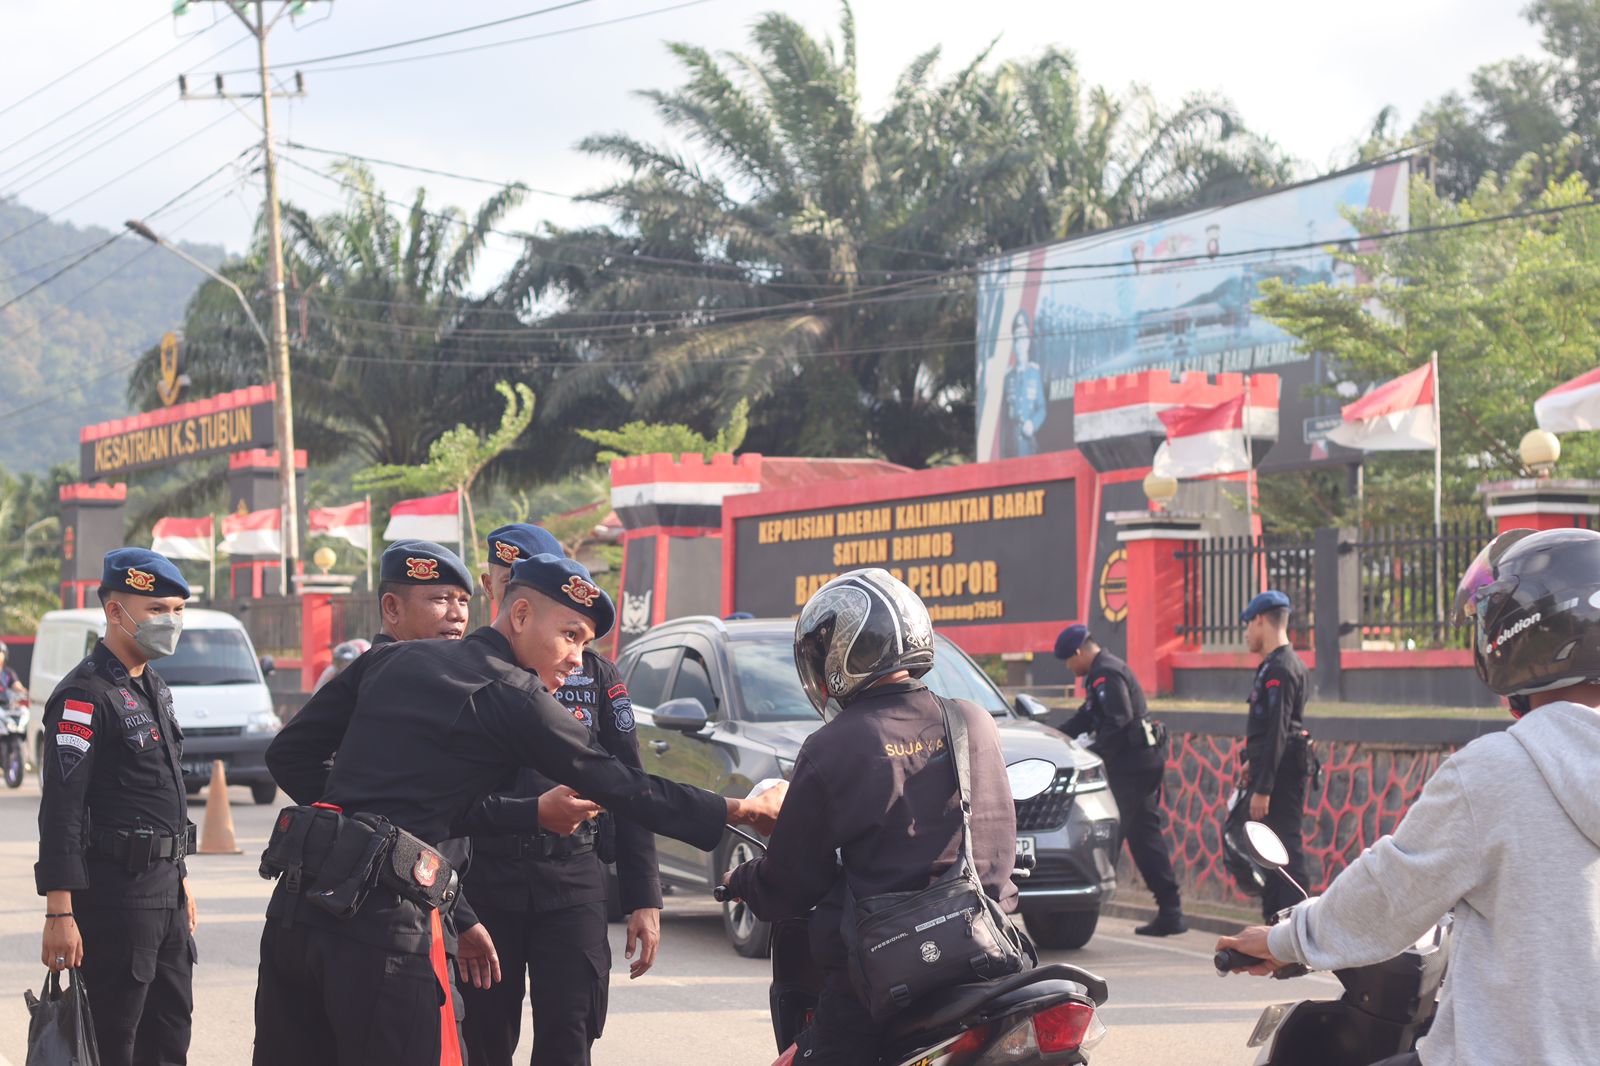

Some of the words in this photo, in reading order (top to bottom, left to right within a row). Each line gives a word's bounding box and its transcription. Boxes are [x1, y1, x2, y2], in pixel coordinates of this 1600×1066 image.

[95, 424, 168, 472] KESATRIAN
[759, 514, 834, 544] KEPOLISIAN
[837, 508, 892, 537] DAERAH
[895, 496, 990, 531] KALIMANTAN
[993, 489, 1046, 521] BARAT
[833, 538, 888, 567] SATUAN
[892, 532, 953, 561] BRIMOB
[907, 560, 998, 598] PELOPOR
[1486, 612, 1542, 654] evolution
[556, 691, 596, 704] POLRI
[60, 723, 89, 738] PELOPOR
[124, 713, 153, 729] RIZAL
